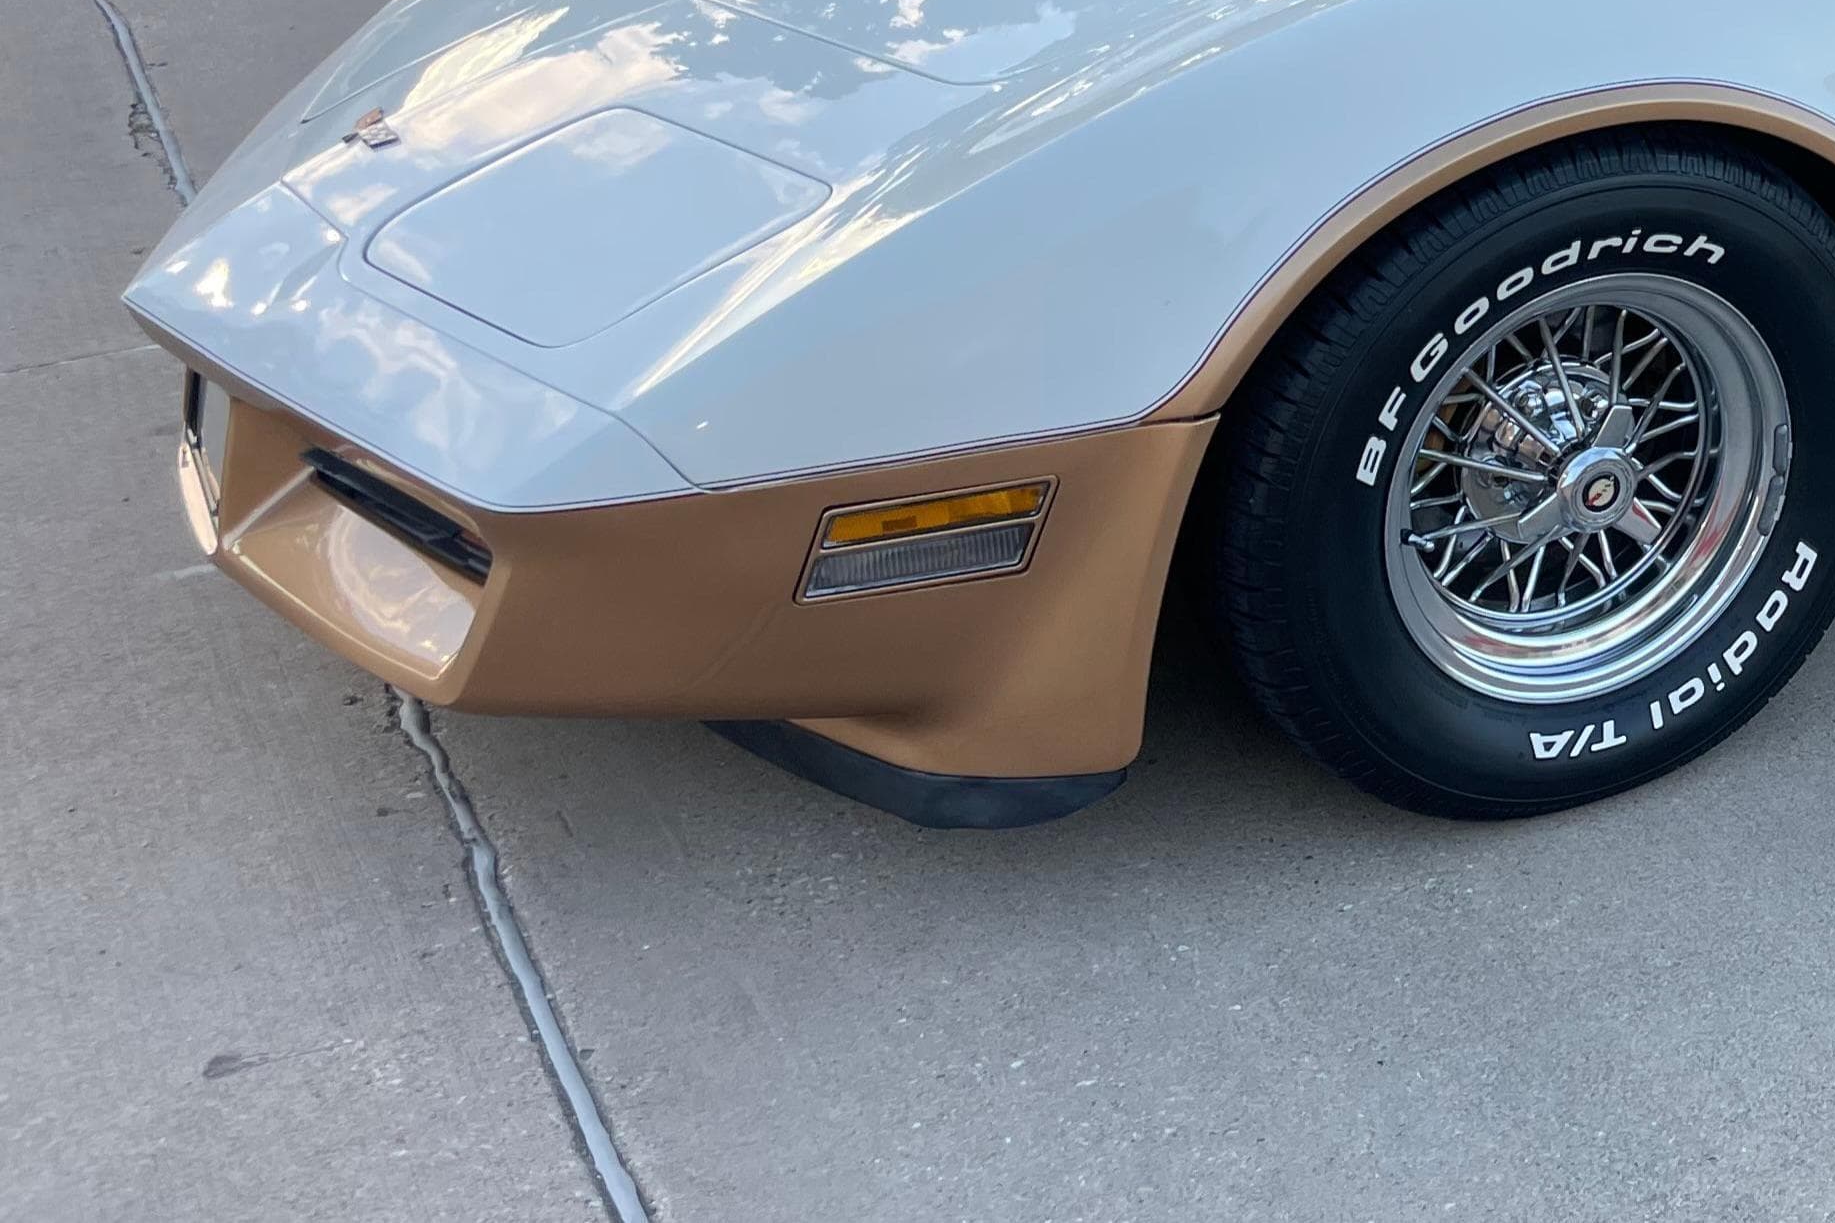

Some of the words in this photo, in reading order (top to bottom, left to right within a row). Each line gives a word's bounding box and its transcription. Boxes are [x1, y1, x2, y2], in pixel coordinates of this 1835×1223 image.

[1355, 227, 1727, 487] BFGoodrich
[1649, 539, 1819, 730] Radial
[1528, 719, 1628, 761] T/A
